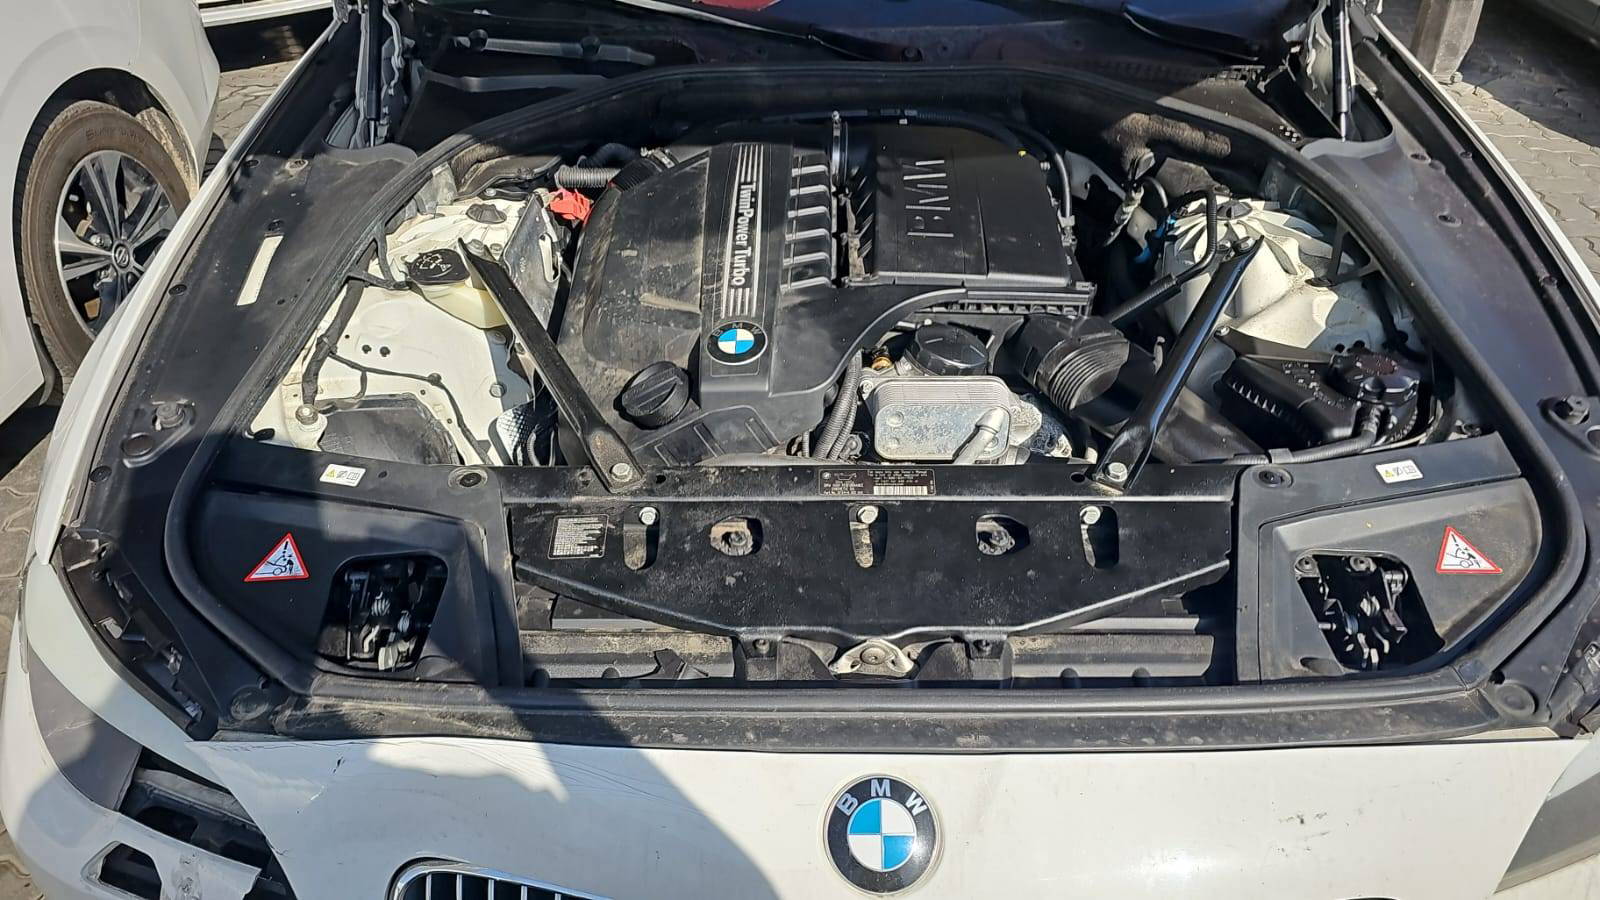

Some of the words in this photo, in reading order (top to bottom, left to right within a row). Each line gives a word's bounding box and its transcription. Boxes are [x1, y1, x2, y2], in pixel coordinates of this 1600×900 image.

[735, 182, 756, 246] TwinPower
[730, 246, 752, 287] Turbo
[836, 779, 927, 817] BMW
